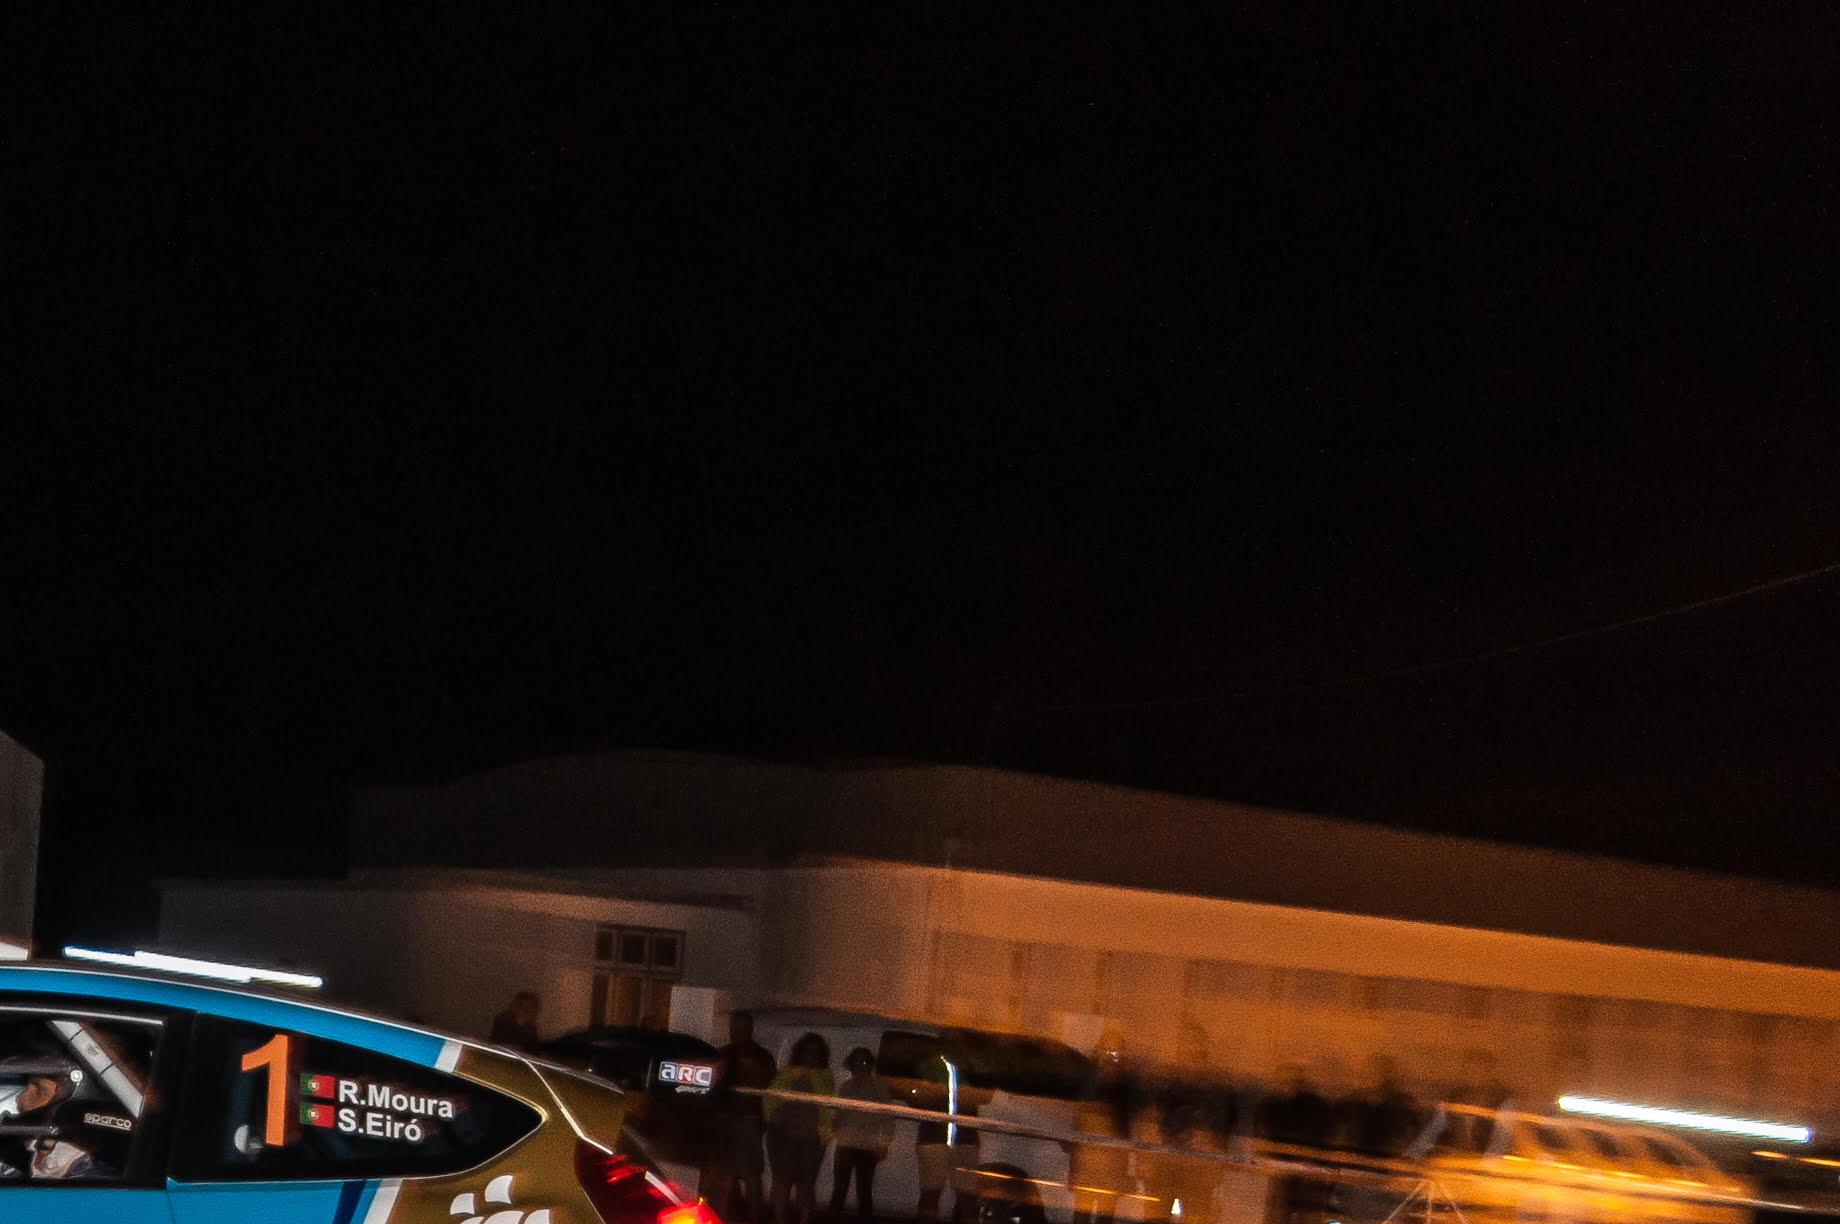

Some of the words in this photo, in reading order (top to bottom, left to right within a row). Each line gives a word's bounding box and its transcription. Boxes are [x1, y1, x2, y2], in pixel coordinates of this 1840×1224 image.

[241, 1033, 289, 1147] 1
[337, 1079, 454, 1119] R.Moura
[84, 1112, 132, 1129] sparco
[337, 1108, 423, 1142] S.Eiró
